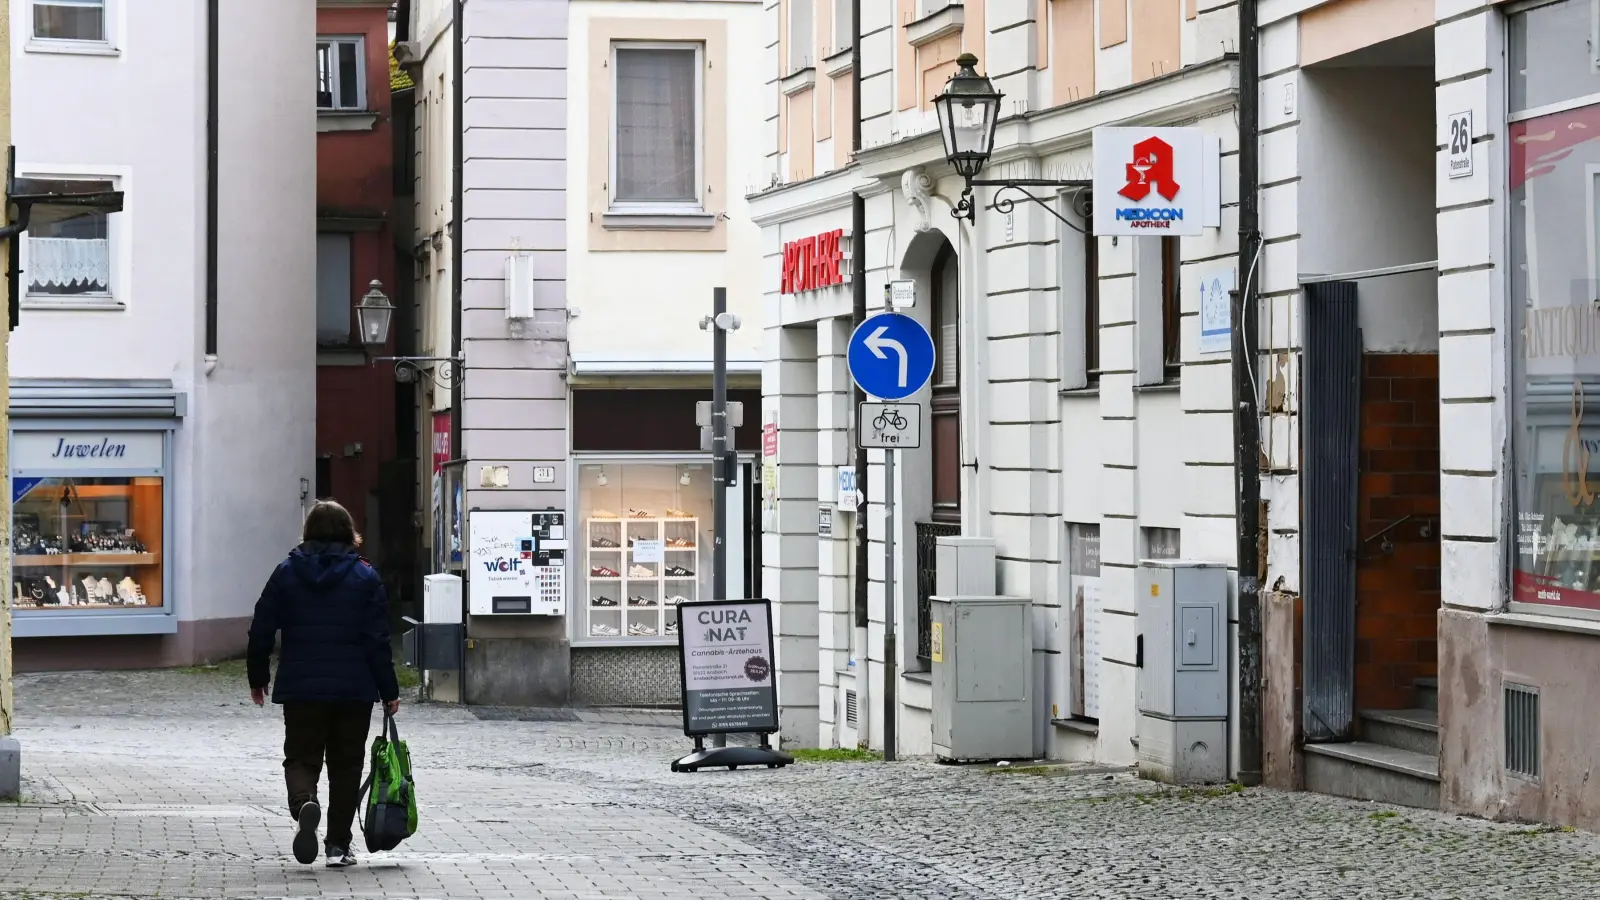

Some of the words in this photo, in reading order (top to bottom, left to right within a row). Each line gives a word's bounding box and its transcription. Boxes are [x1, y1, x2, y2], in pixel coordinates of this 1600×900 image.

[1451, 117, 1468, 155] 26
[1116, 208, 1184, 221] MEDICON
[1130, 220, 1170, 229] APOTHEKE
[781, 228, 843, 295] APOTHEKE
[881, 433, 900, 443] frei
[51, 438, 126, 457] Juwelen
[539, 468, 550, 478] 31
[697, 609, 752, 625] CURA
[709, 627, 747, 642] NAT
[691, 648, 763, 657] Cannabis-Ärztehaus
